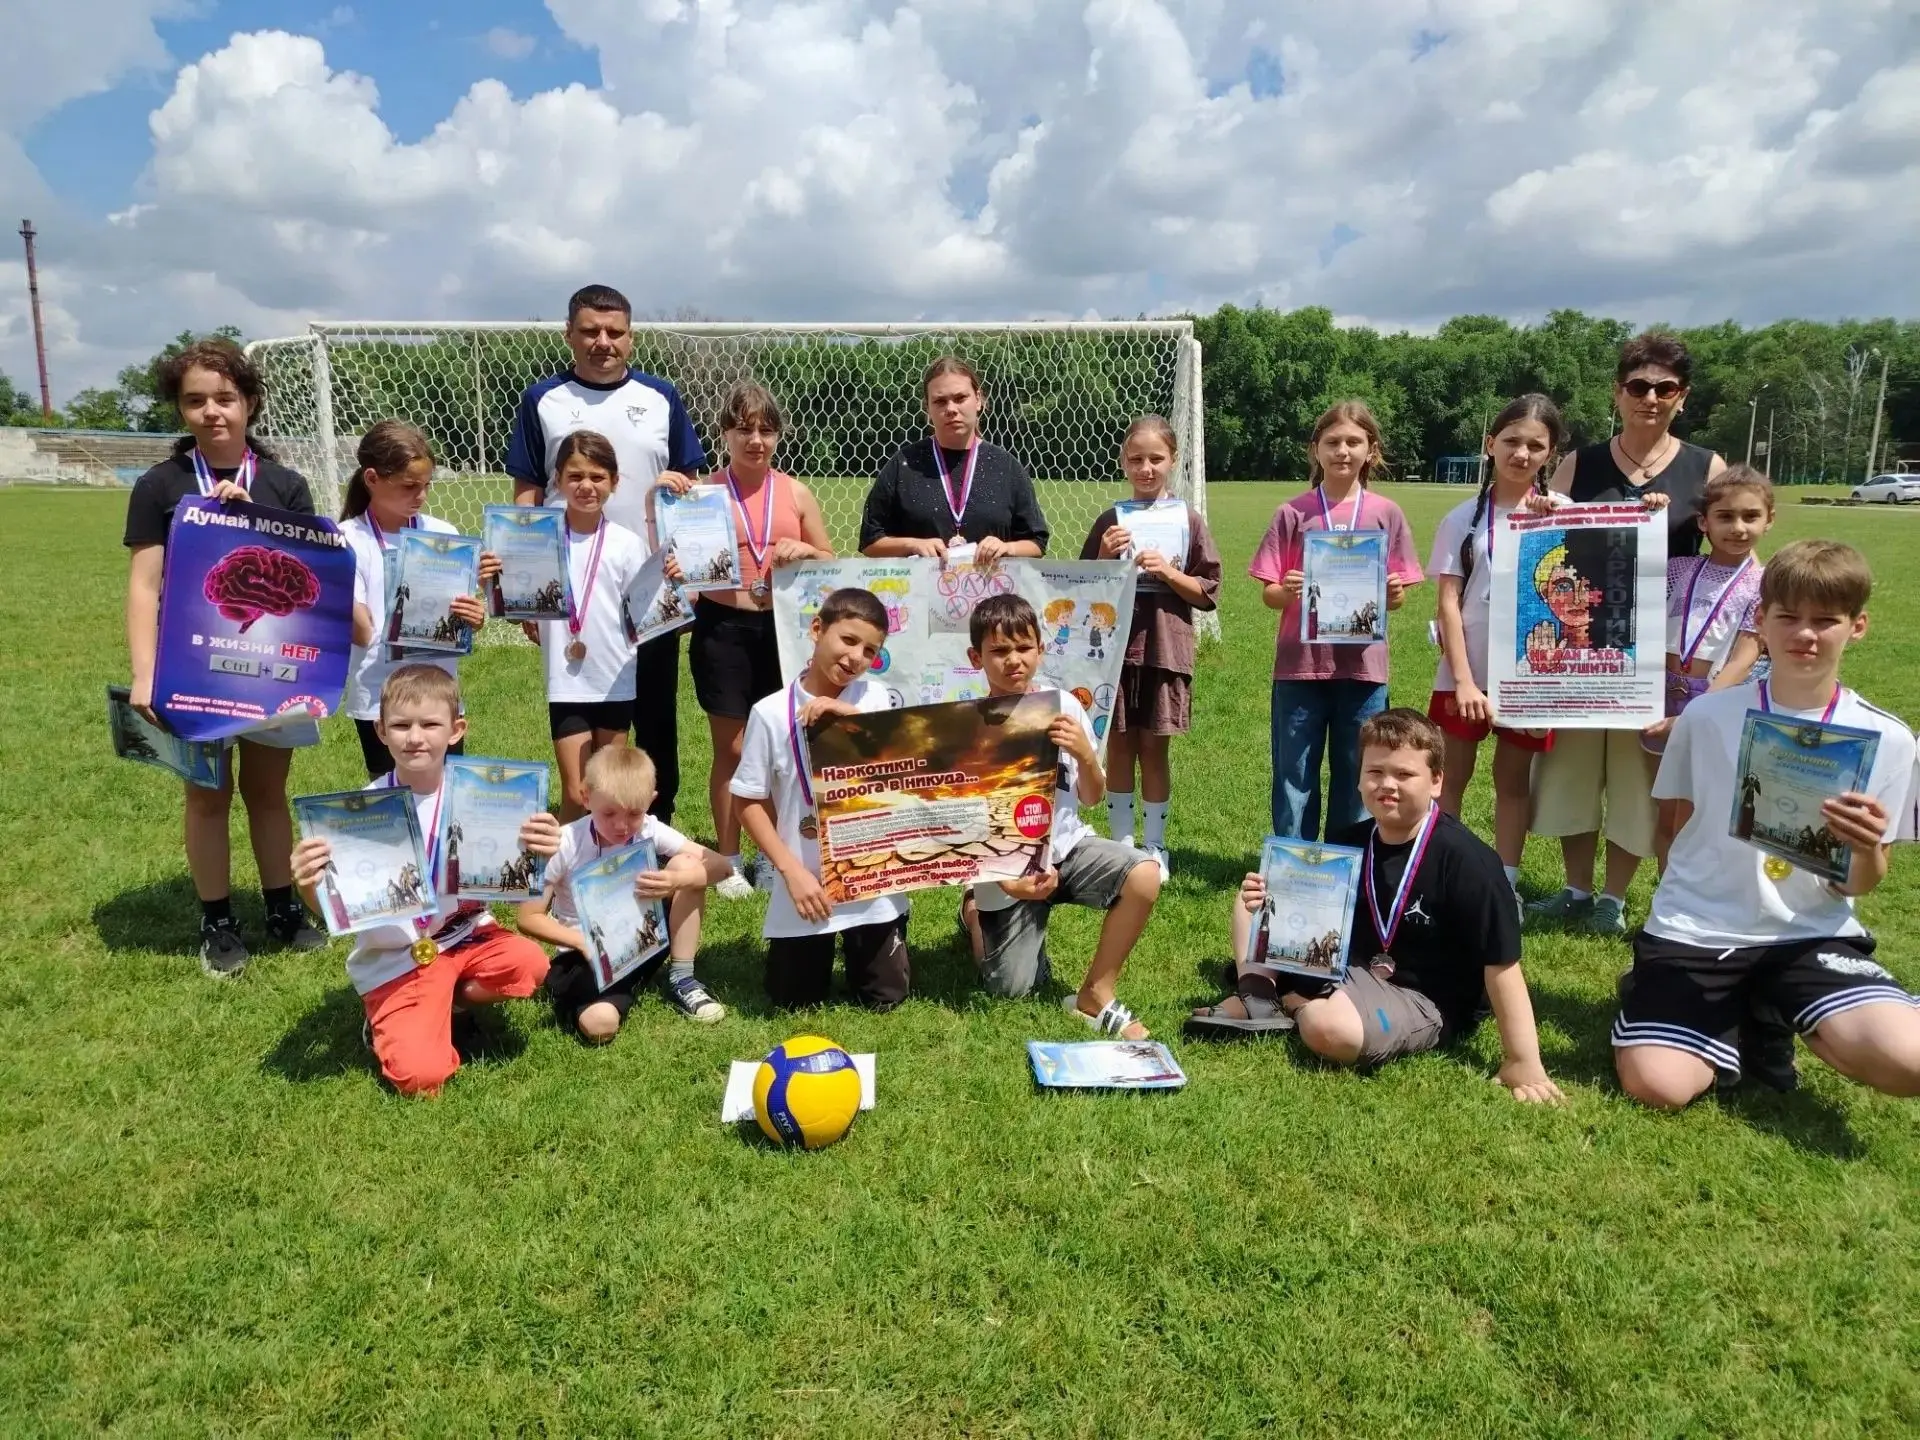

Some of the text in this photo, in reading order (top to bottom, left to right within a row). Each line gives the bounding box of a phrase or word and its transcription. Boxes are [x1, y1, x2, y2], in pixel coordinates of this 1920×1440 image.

[183, 506, 347, 548] Думай МОЗГАМИ
[1606, 531, 1628, 647] НАРКОТИК
[280, 642, 320, 662] НЕТ
[1587, 649, 1624, 661] СЕБЯ
[221, 657, 250, 673] Ctrl
[280, 667, 291, 679] Z
[1530, 661, 1624, 674] РАЗРУШИТЬ!
[166, 702, 173, 710] и
[174, 703, 204, 714] жизнь
[205, 706, 231, 716] своих
[172, 693, 210, 705] Сохрани
[212, 698, 236, 707] свою
[276, 695, 314, 714] СПАСИ
[823, 758, 915, 783] Наркотики
[826, 771, 979, 802] дорога в никуда...
[1024, 803, 1042, 815] СТОП
[843, 871, 878, 884] Сделай
[880, 860, 940, 878] правильный
[851, 886, 858, 894] в
[860, 879, 893, 892] пользу
[895, 875, 928, 886] своего
